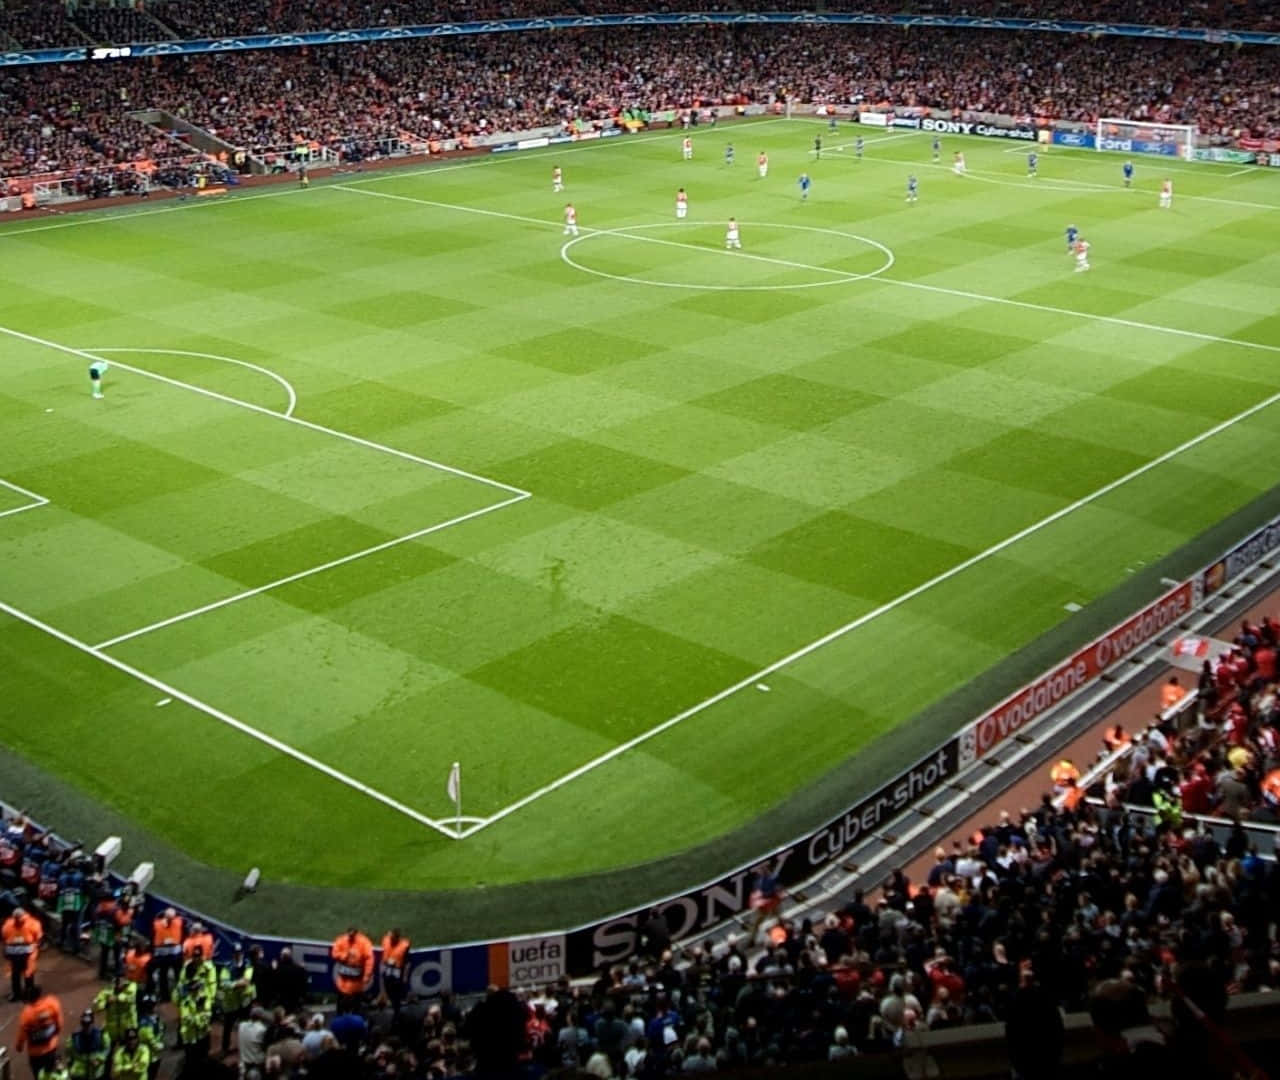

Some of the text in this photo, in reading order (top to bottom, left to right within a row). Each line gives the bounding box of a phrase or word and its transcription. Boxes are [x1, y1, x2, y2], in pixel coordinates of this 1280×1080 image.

[923, 118, 974, 135] SONY
[1112, 593, 1186, 657] vodafone
[998, 660, 1087, 738] vodafone
[807, 749, 950, 866] Cyber-shot
[511, 939, 562, 964] uefa
